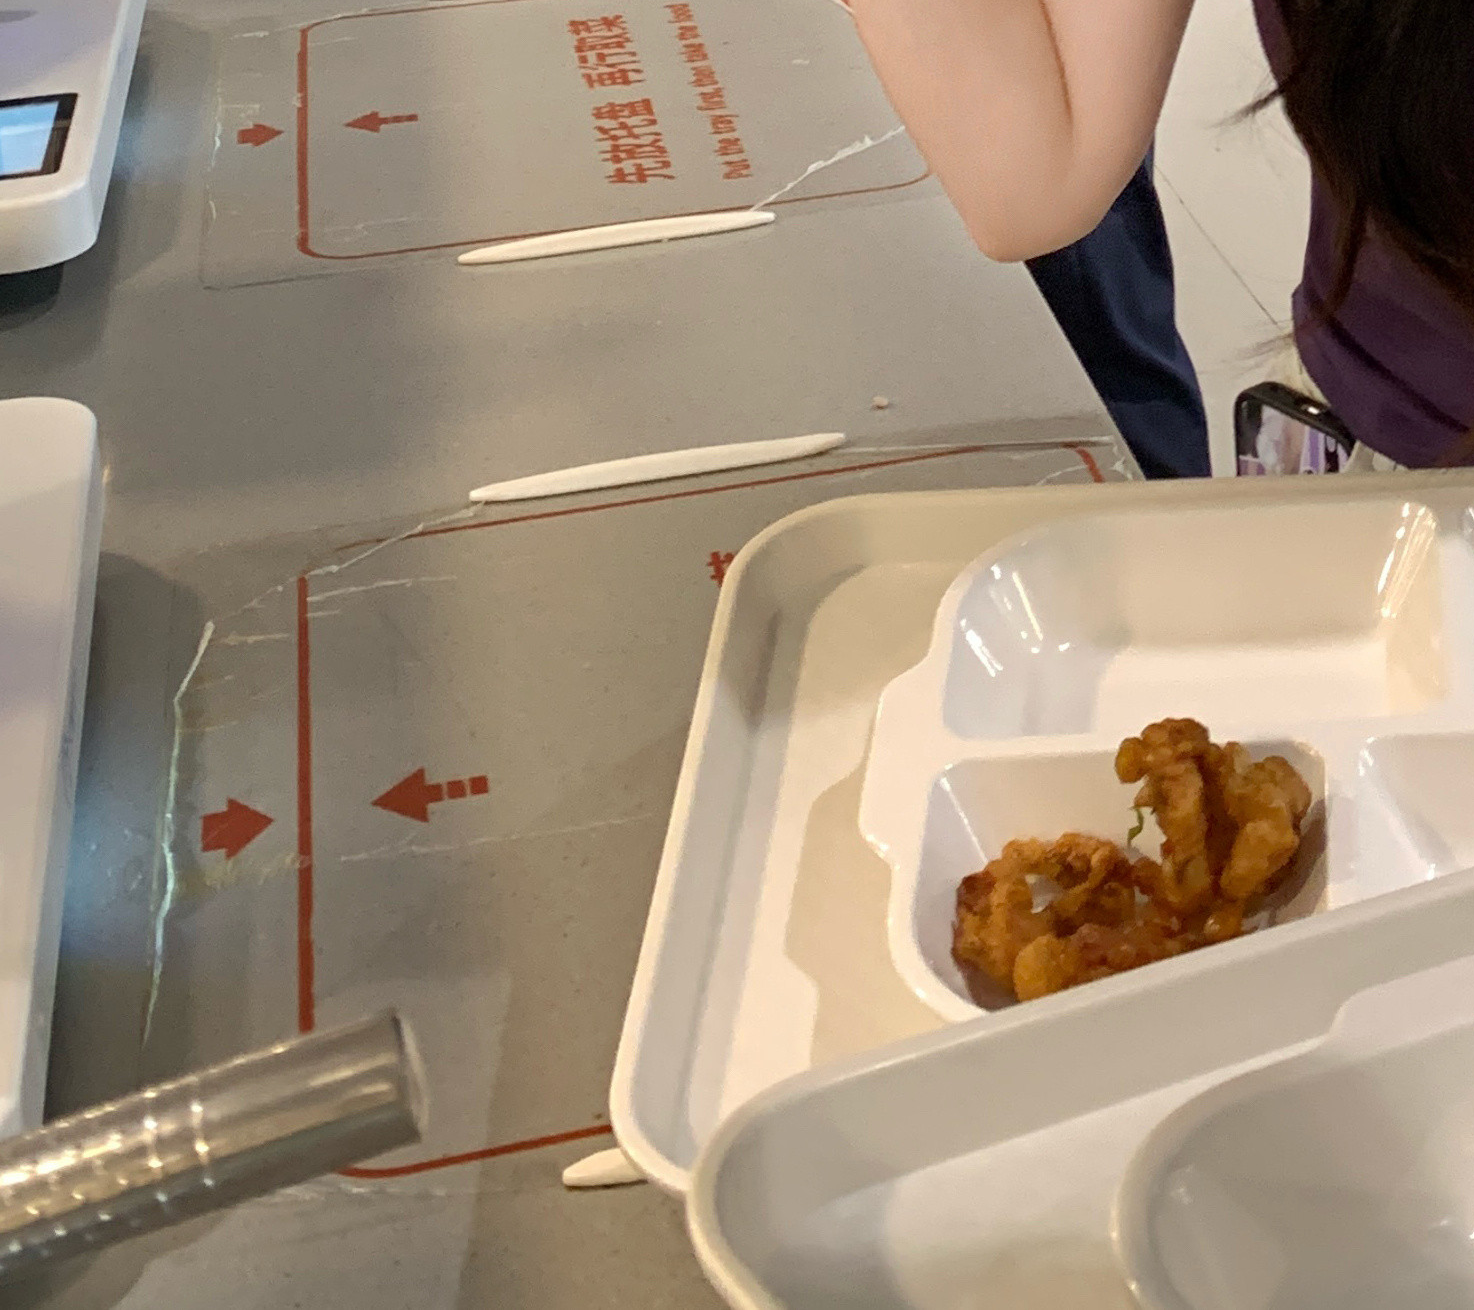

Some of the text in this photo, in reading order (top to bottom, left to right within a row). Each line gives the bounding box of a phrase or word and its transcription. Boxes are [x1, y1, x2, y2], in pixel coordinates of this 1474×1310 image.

[674, 24, 700, 41] the
[679, 42, 710, 63] take
[689, 64, 718, 87] then
[567, 14, 675, 184] 先放托盘 再行取菜
[708, 113, 738, 134] tray
[715, 137, 744, 156] the
[720, 157, 753, 180] Put
